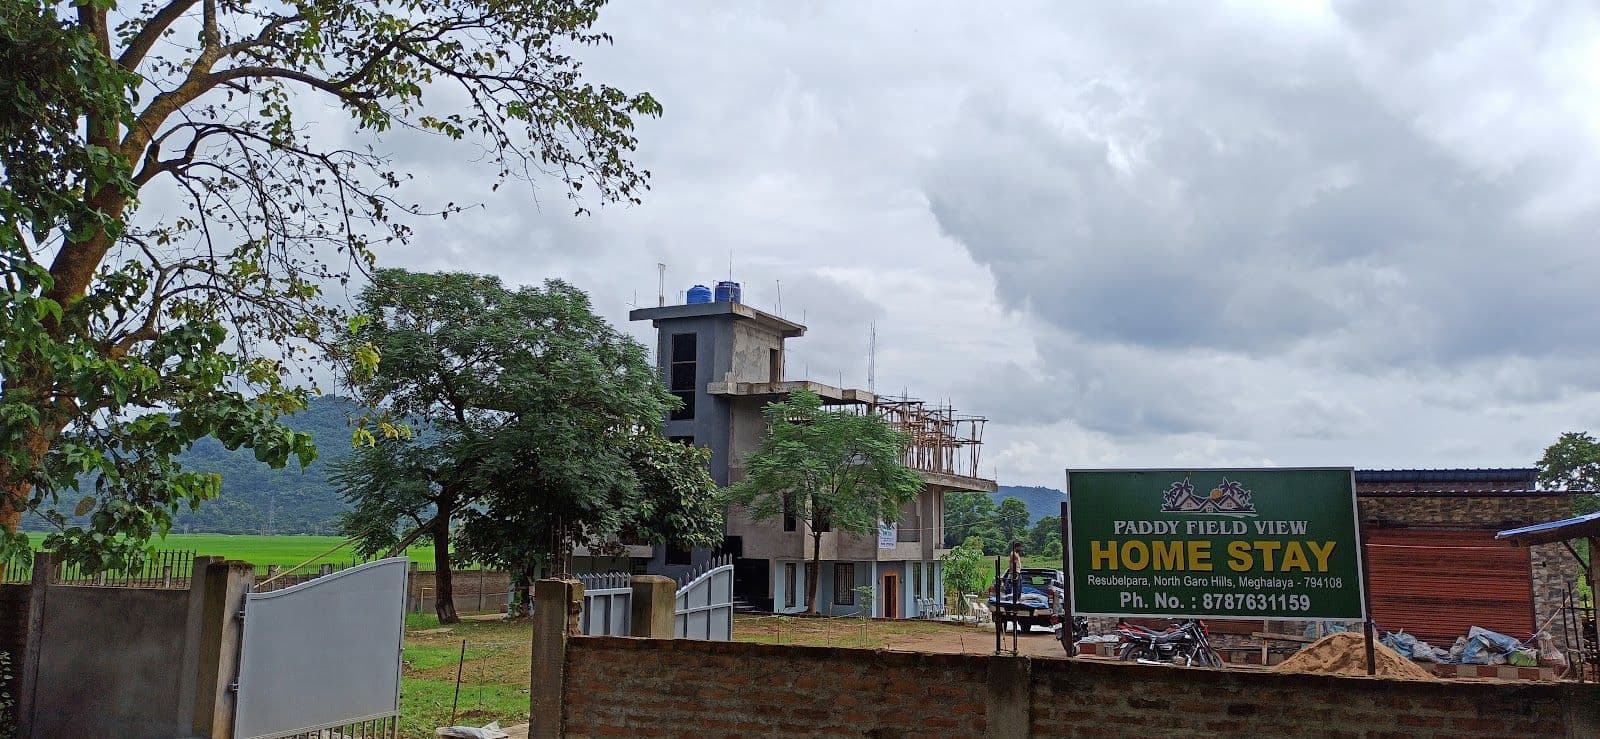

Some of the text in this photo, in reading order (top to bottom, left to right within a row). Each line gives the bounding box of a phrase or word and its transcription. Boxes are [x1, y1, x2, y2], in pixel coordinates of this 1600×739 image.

[1114, 521, 1307, 534] PADDY FIELD VIEW
[1092, 541, 1336, 571] HOME STAY
[1088, 575, 1150, 587] Resubelpara,
[1154, 576, 1180, 586] North
[1184, 576, 1208, 586] Garo
[1211, 576, 1235, 588] Hills,
[1239, 577, 1293, 590] Meghalaya
[1304, 577, 1342, 588] 794108
[1120, 592, 1148, 608] Ph.
[1155, 593, 1184, 608] No.
[1203, 593, 1310, 610] 8787631159
